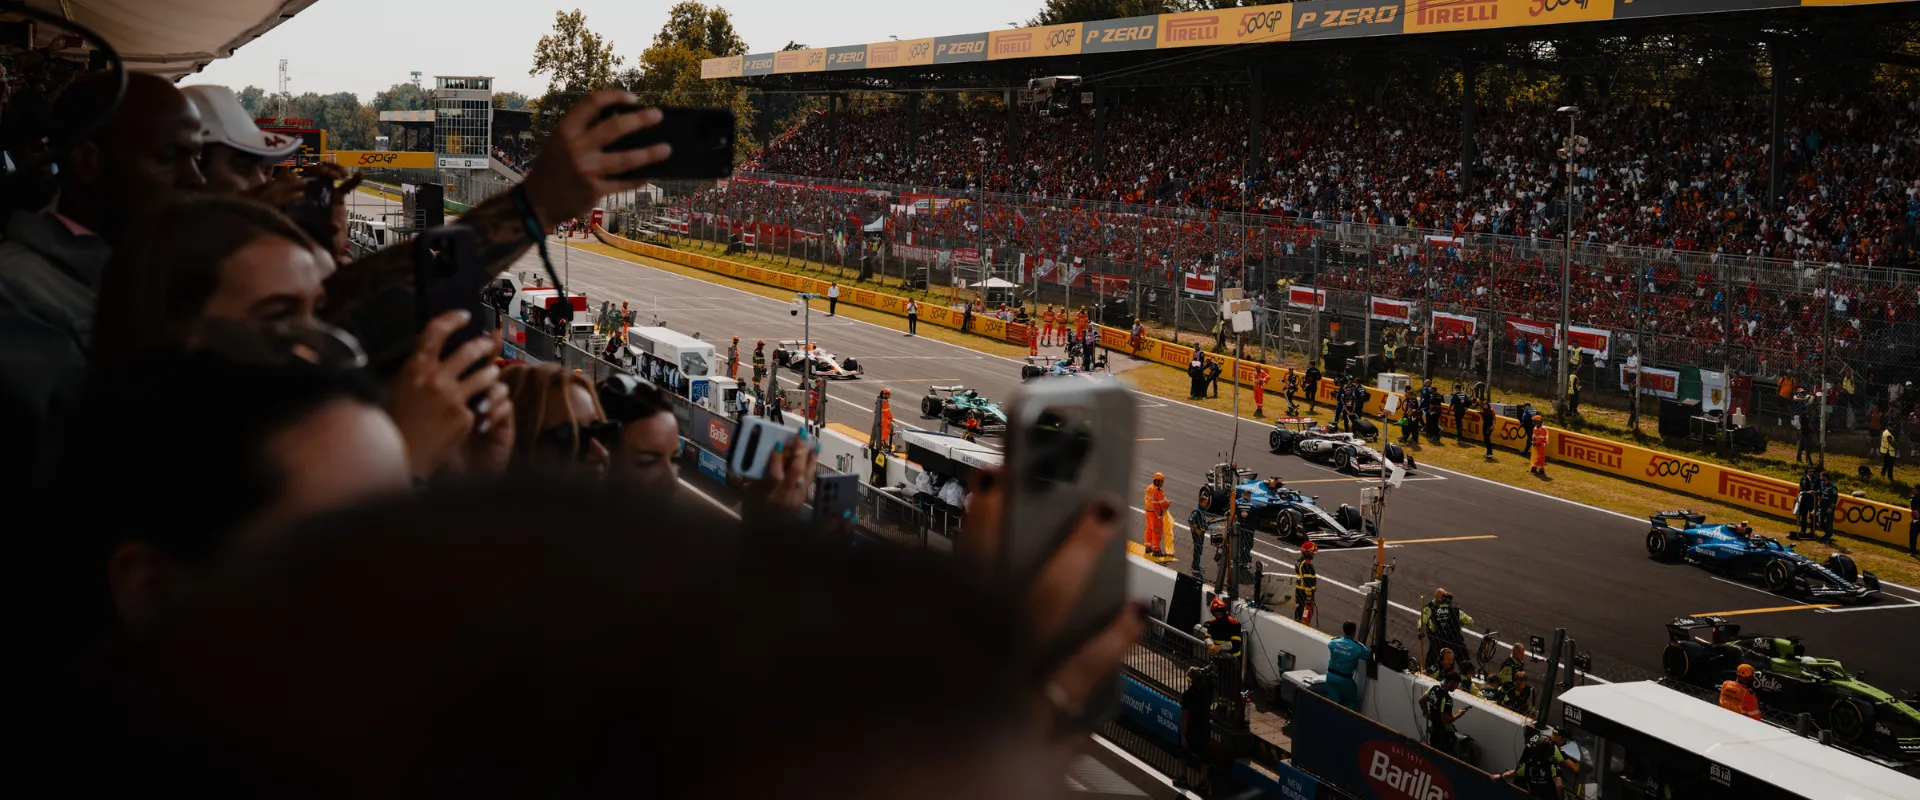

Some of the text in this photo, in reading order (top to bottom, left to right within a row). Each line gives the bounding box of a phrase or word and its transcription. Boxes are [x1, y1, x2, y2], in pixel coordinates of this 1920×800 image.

[1297, 5, 1398, 28] P ZERO
[1417, 0, 1498, 25] PIRELLI
[1165, 16, 1219, 42] PIRELLI
[1237, 10, 1282, 38] 500GP
[994, 33, 1032, 55] PIRELLI
[1045, 29, 1075, 52] 500GP
[1085, 26, 1154, 44] P ZERO
[827, 52, 865, 64] P ZERO
[870, 46, 899, 64] PIRELLI
[936, 40, 985, 56] P ZERO
[743, 59, 773, 70] P ZERO
[264, 136, 286, 148] 44
[358, 154, 397, 165] 500GP
[1161, 343, 1190, 366] PIRELLI
[709, 424, 728, 445] Barilla
[1500, 421, 1526, 441] 500
[1558, 433, 1623, 469] PIRELLI
[1646, 455, 1699, 483] 500GP
[1718, 470, 1800, 512] PIRELL
[1833, 498, 1902, 532] 500GP
[1753, 637, 1771, 650] Stake
[1752, 671, 1782, 691] Stake
[1160, 707, 1174, 719] NEW
[1156, 716, 1179, 733] SEASON
[1287, 777, 1303, 792] NEW
[1369, 750, 1445, 800] Barilla
